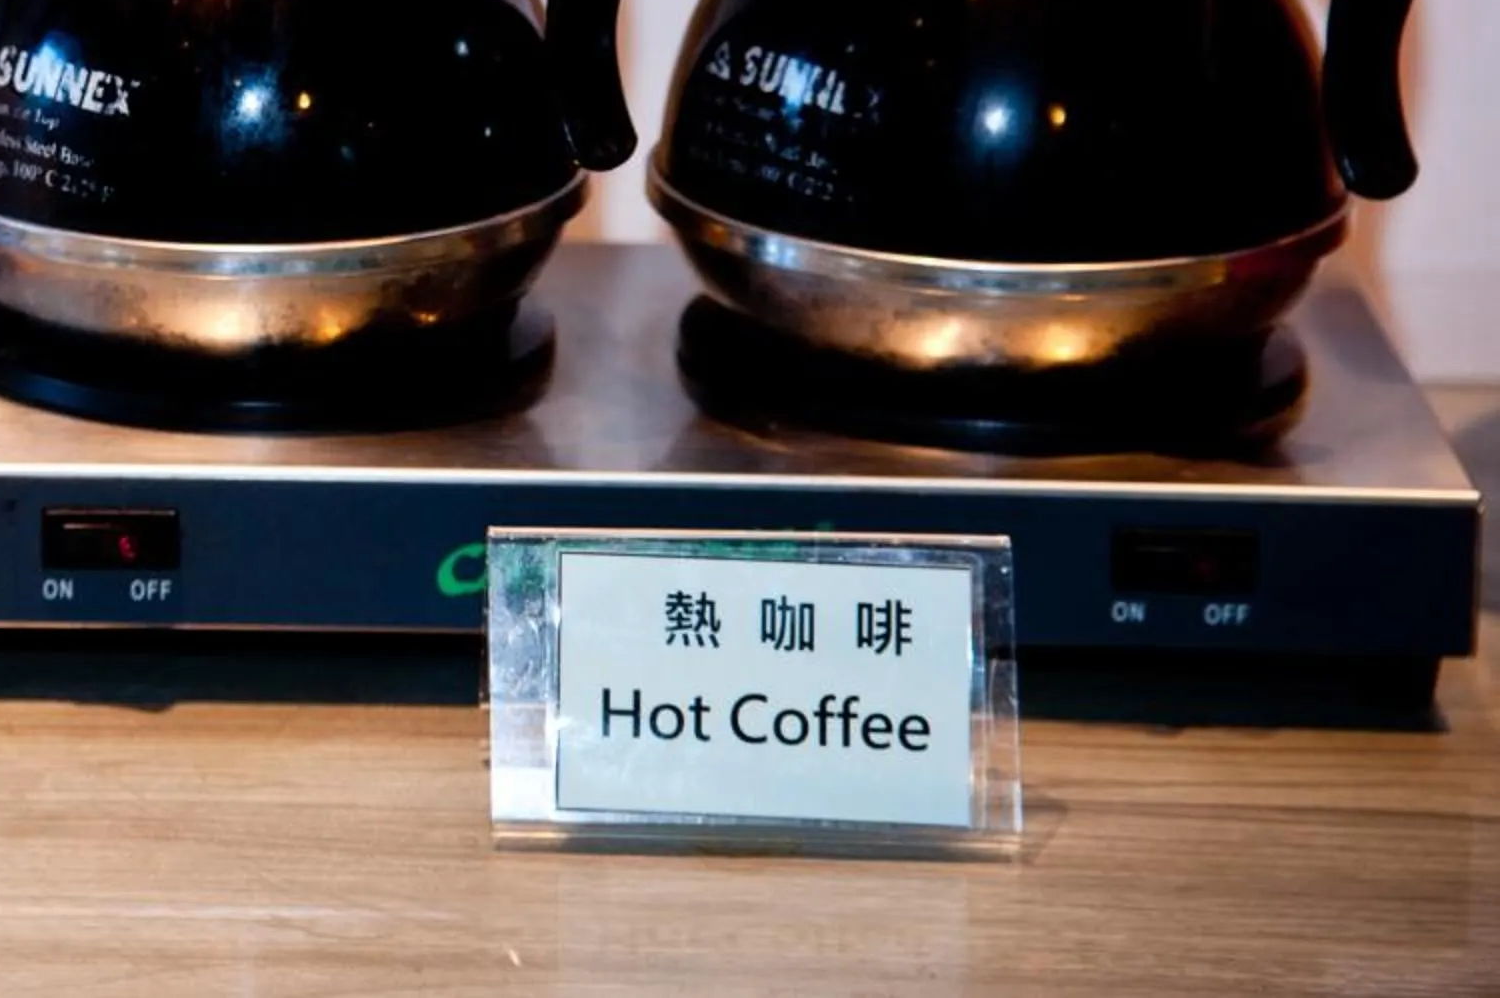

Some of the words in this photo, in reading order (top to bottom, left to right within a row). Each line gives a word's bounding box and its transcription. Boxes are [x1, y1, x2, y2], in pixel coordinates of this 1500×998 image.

[42, 578, 74, 600] ON
[130, 579, 173, 602] OFF
[1111, 601, 1145, 622] ON
[1204, 603, 1250, 626] OFF
[601, 688, 711, 742] Hot
[730, 693, 932, 752] Coffee
